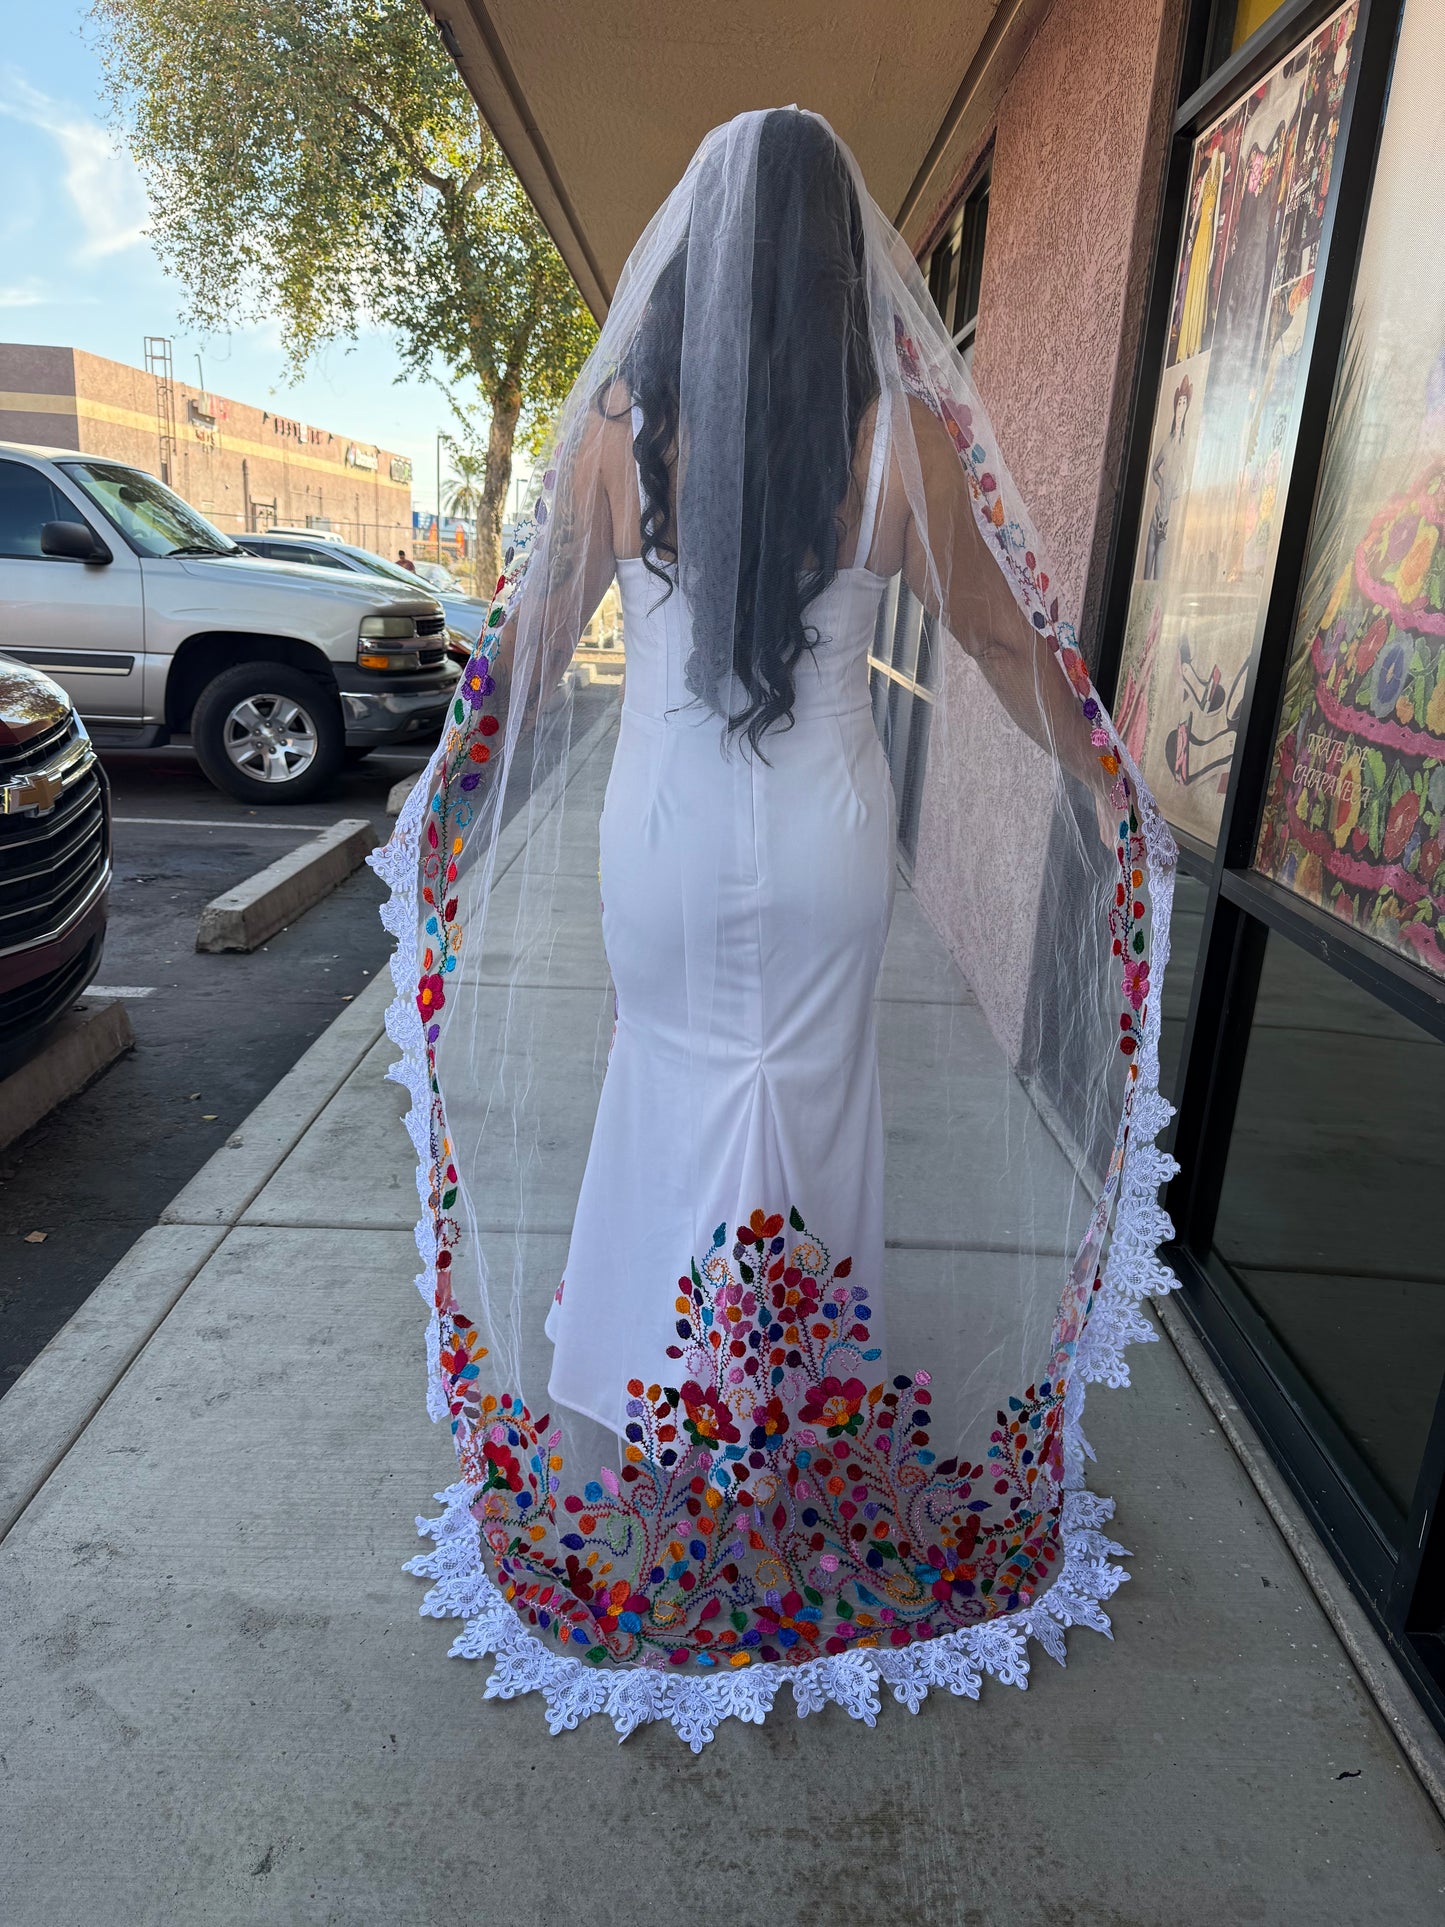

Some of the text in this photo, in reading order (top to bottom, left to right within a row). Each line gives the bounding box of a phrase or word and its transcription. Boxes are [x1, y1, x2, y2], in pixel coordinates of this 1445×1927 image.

[1307, 733, 1370, 770] TRAJES DE
[1292, 764, 1373, 808] CHIAPANECA
